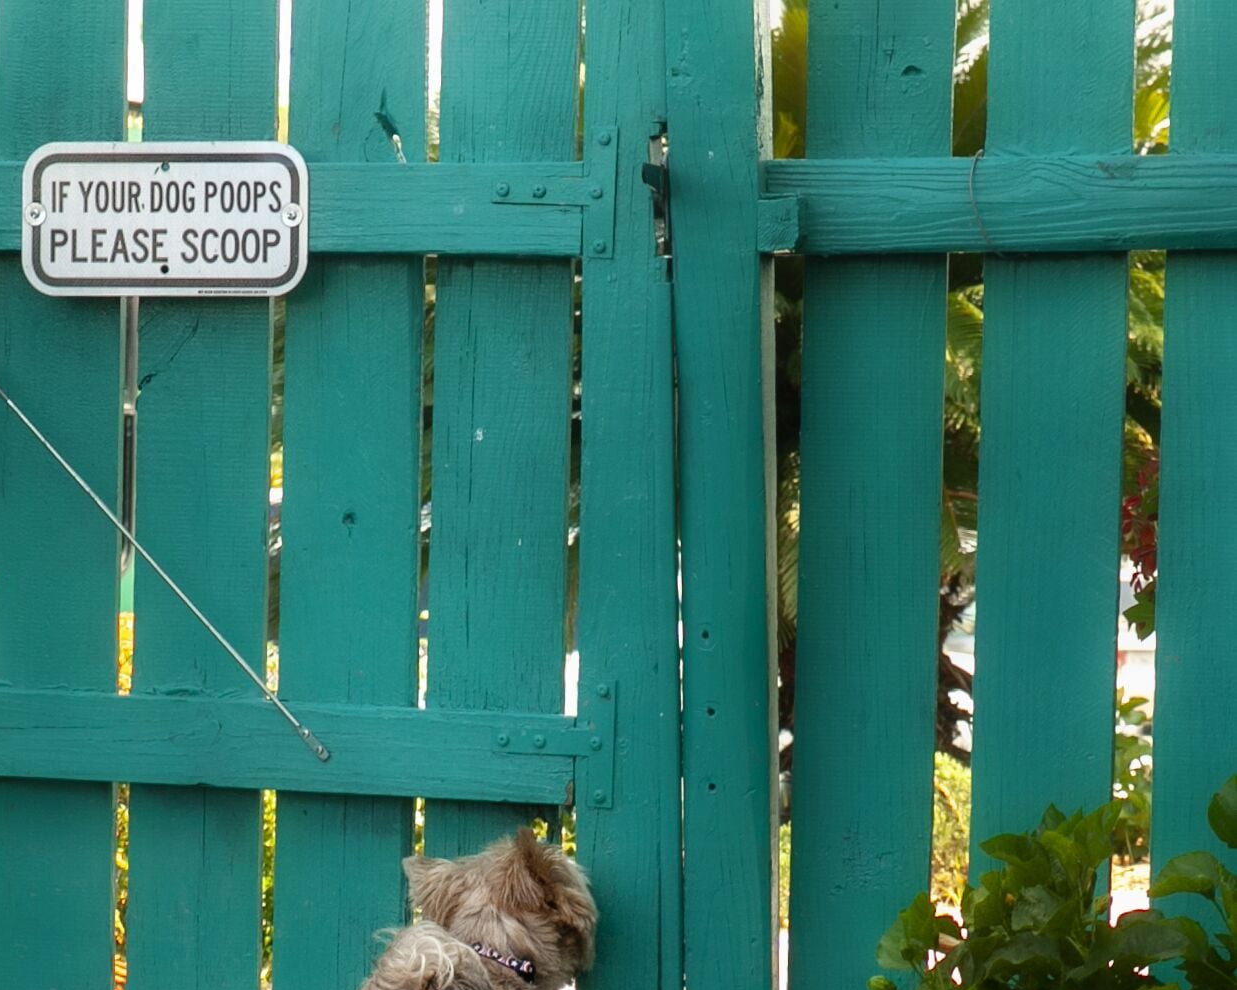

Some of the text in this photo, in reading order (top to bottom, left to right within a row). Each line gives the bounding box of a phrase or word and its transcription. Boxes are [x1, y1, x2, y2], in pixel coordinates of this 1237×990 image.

[51, 181, 282, 213] IF YOUR DOG POOPS
[50, 229, 281, 263] PLEASE SCOOP
